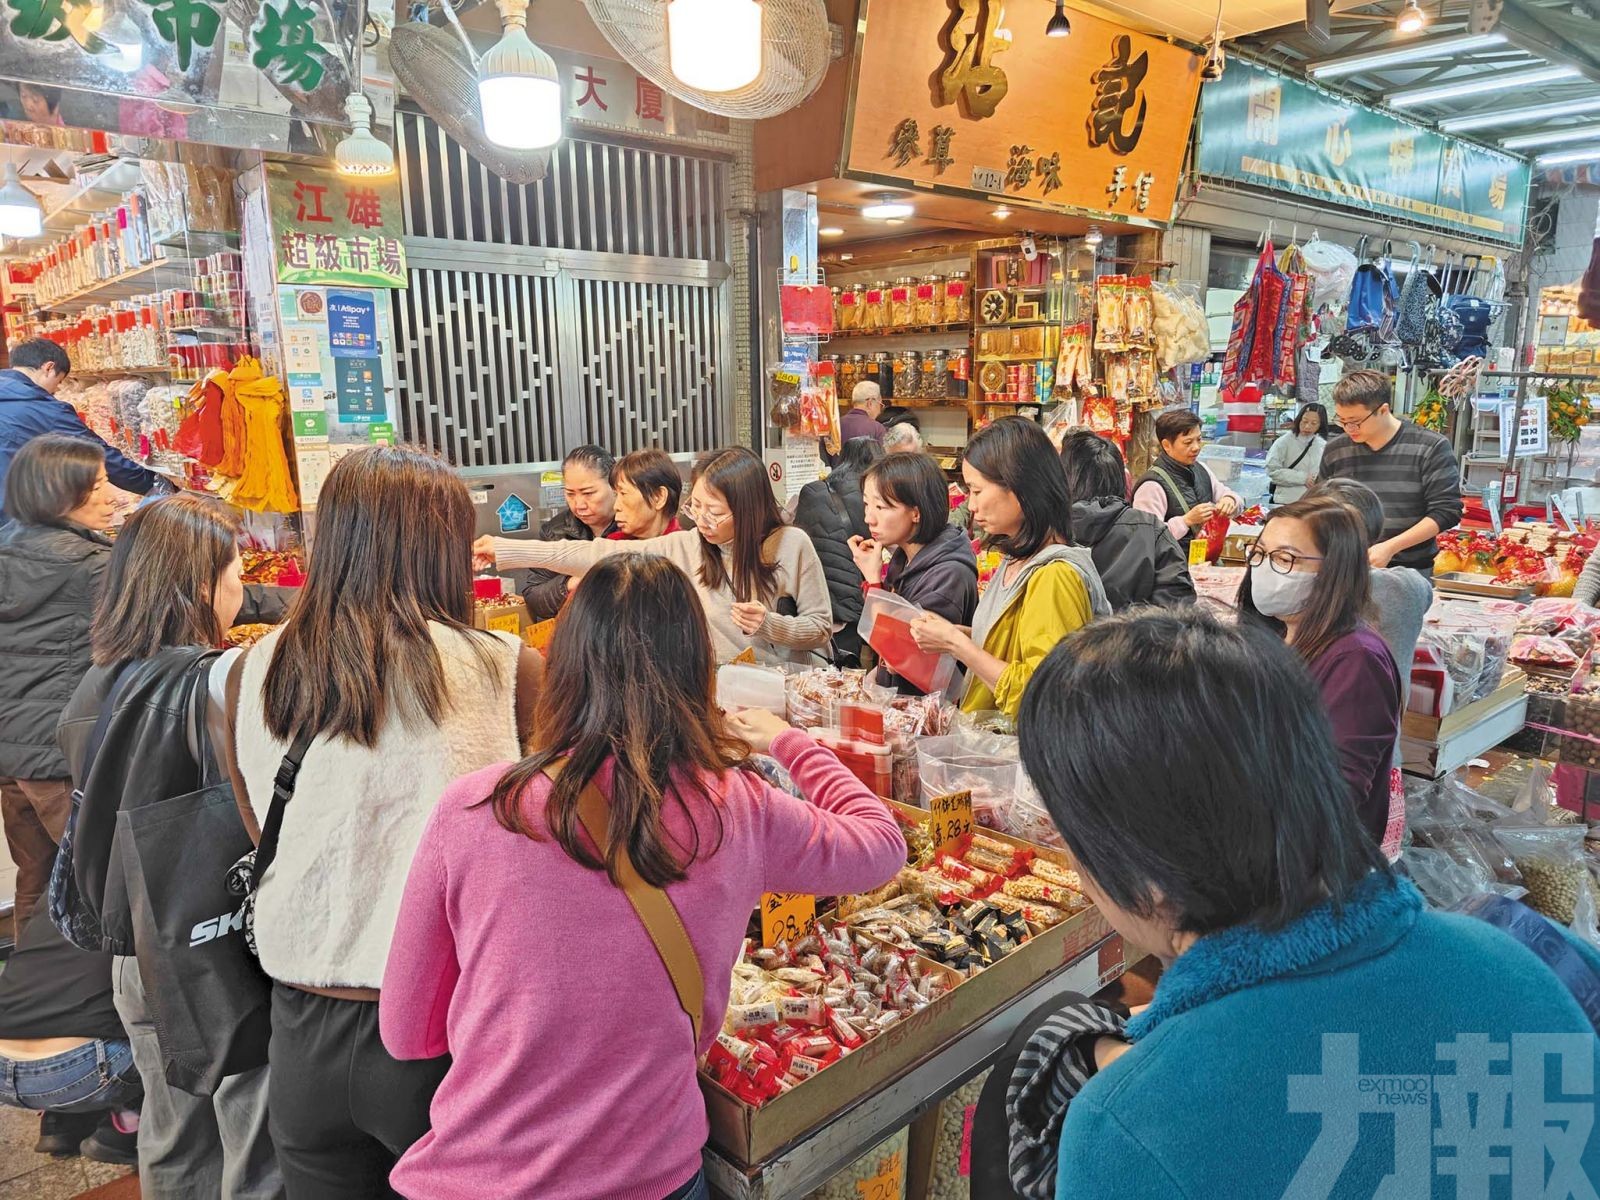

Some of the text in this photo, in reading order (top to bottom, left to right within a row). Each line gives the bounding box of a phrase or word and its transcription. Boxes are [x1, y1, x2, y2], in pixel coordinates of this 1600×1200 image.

[575, 66, 665, 122] 大廈
[1004, 144, 1063, 195] 海味
[1107, 165, 1156, 212] 手信
[293, 180, 384, 229] 江雄
[281, 231, 401, 275] 超級市場
[189, 910, 244, 948] SK
